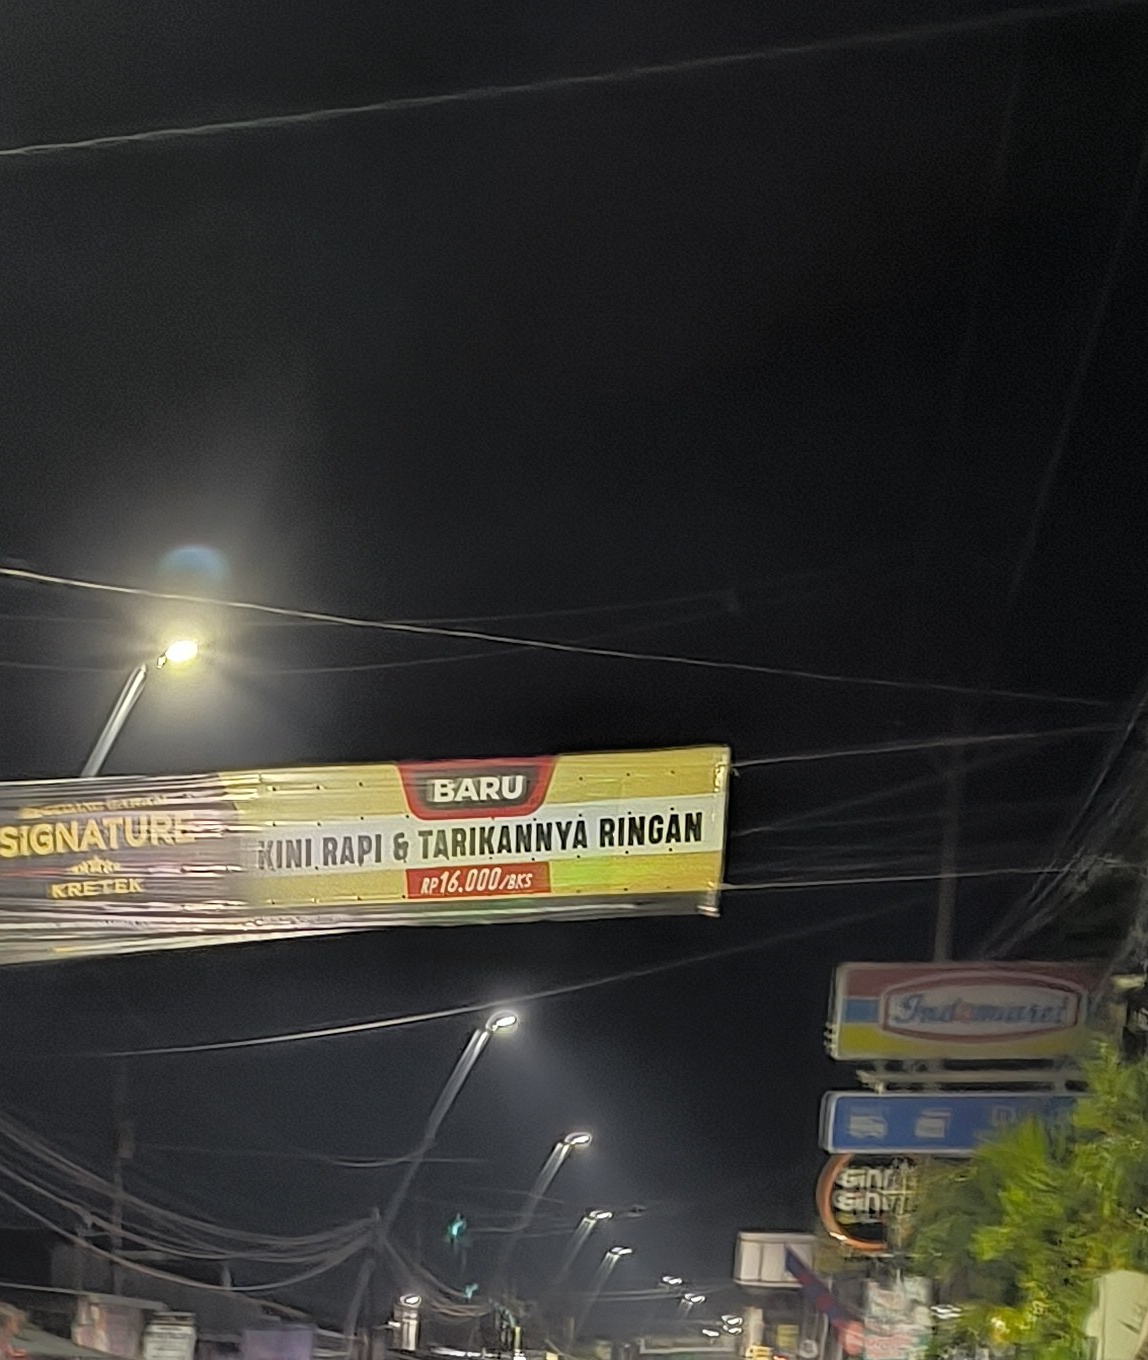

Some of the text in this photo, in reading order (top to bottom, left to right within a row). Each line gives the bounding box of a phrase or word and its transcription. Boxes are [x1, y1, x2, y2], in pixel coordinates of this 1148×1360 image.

[433, 775, 525, 802] BARU
[258, 811, 702, 872] KINI RAPI & TARIKANNYA RINGAN
[51, 878, 145, 899] KRETEK
